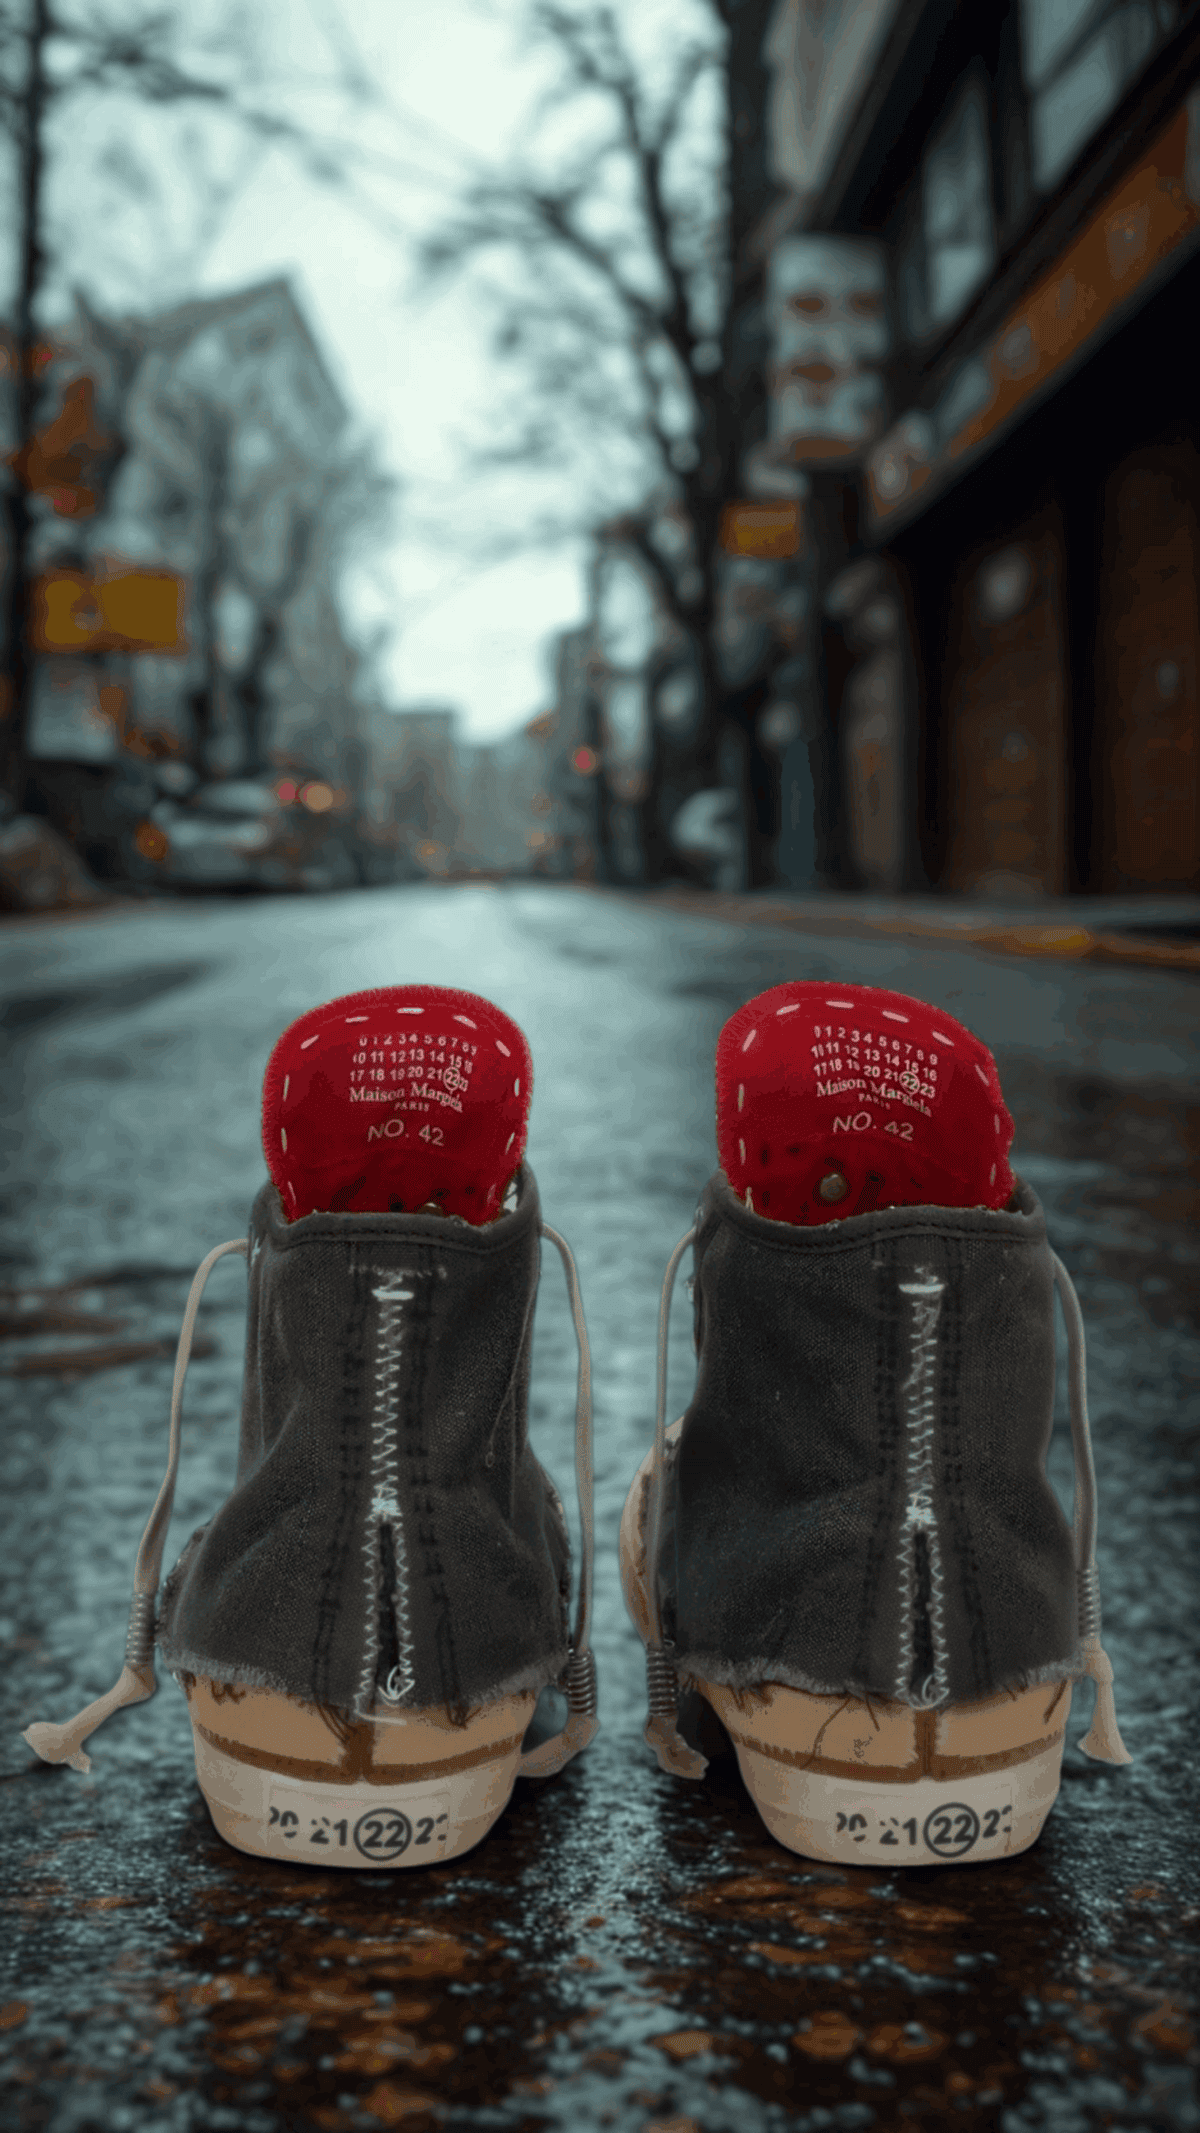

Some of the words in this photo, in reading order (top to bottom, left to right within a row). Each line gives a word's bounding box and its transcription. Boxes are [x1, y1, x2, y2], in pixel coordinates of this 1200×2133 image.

[374, 1037, 378, 1045] 1
[384, 1035, 392, 1045] 2
[399, 1034, 406, 1044] 3
[409, 1034, 418, 1043] 4
[424, 1035, 433, 1044] 5
[438, 1036, 446, 1046] 6
[452, 1037, 458, 1047] 7
[825, 1026, 831, 1037] 1
[838, 1027, 845, 1039] 2
[851, 1030, 860, 1042] 3
[863, 1032, 872, 1043] 4
[879, 1036, 887, 1047] 5
[892, 1040, 900, 1051] 6
[905, 1044, 912, 1054] 7
[353, 1052, 366, 1064] 10
[370, 1051, 384, 1063] 11
[390, 1050, 406, 1063] 12
[409, 1049, 425, 1061] 13
[430, 1050, 445, 1063] 14
[450, 1054, 462, 1068] 15
[826, 1042, 840, 1054] 11
[845, 1045, 859, 1058] 12
[864, 1049, 880, 1061] 13
[885, 1053, 900, 1066] 14
[904, 1060, 919, 1074] 15
[923, 1067, 937, 1081] 16
[350, 1070, 365, 1081] 17
[370, 1069, 385, 1081] 18
[390, 1068, 405, 1081] 19
[408, 1066, 423, 1077] 20
[427, 1067, 442, 1080] 21
[830, 1058, 842, 1072] 18
[863, 1065, 881, 1078] 20
[884, 1068, 899, 1082] 21
[920, 1083, 936, 1099] 23
[350, 1085, 405, 1102] Maison
[817, 1077, 867, 1097] Maison
[395, 1102, 429, 1112] PARIS
[367, 1119, 409, 1142] NO.
[419, 1124, 444, 1146] 42
[833, 1112, 877, 1133] NO.
[884, 1121, 914, 1141] 42
